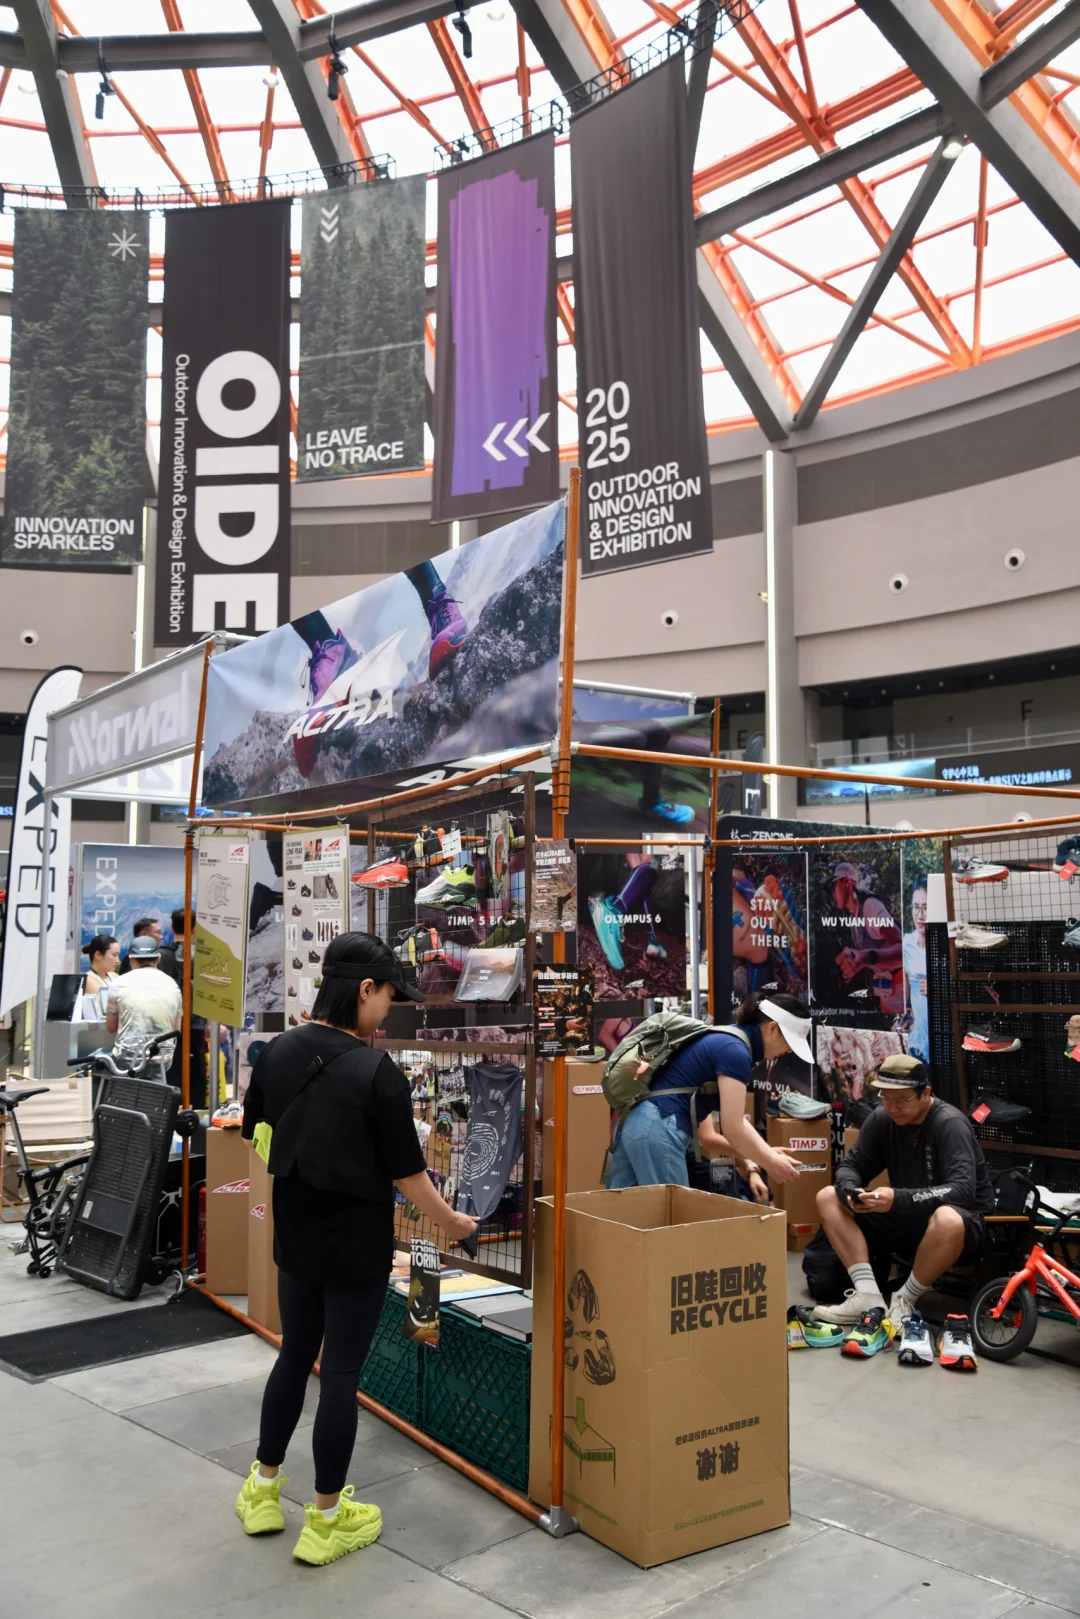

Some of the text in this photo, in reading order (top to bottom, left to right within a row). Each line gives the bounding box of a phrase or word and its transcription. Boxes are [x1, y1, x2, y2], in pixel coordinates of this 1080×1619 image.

[585, 381, 630, 428] 20
[306, 426, 368, 450] LEAVE
[586, 423, 631, 470] 25
[305, 441, 404, 469] NO TRACE
[168, 354, 190, 633] Outdoor Innovation & Design Exhibition
[193, 350, 281, 632] OIDE
[588, 462, 679, 500] OUTDOOR
[589, 477, 701, 521] INNOVATION
[14, 517, 134, 535] INNOVATION
[589, 504, 674, 540] & DESIGN
[14, 533, 115, 551] SPARKLES
[590, 521, 692, 560] EXHIBITION
[283, 690, 394, 744] ALTRA
[604, 914, 661, 924] OLYMPUS 6
[750, 899, 778, 911] STAY
[447, 916, 474, 926] TIMP
[479, 916, 486, 926] 5
[750, 917, 774, 929] OUT
[821, 917, 894, 927] WU YUAN YUAN
[751, 934, 788, 948] THERE
[753, 1080, 791, 1094] FWD VIA
[791, 1140, 827, 1149] TIMP 5
[411, 1251, 437, 1270] TORIN
[671, 1262, 766, 1308] 旧鞋回收
[671, 1295, 767, 1335] RECYCLE
[696, 1441, 740, 1481] 谢谢
